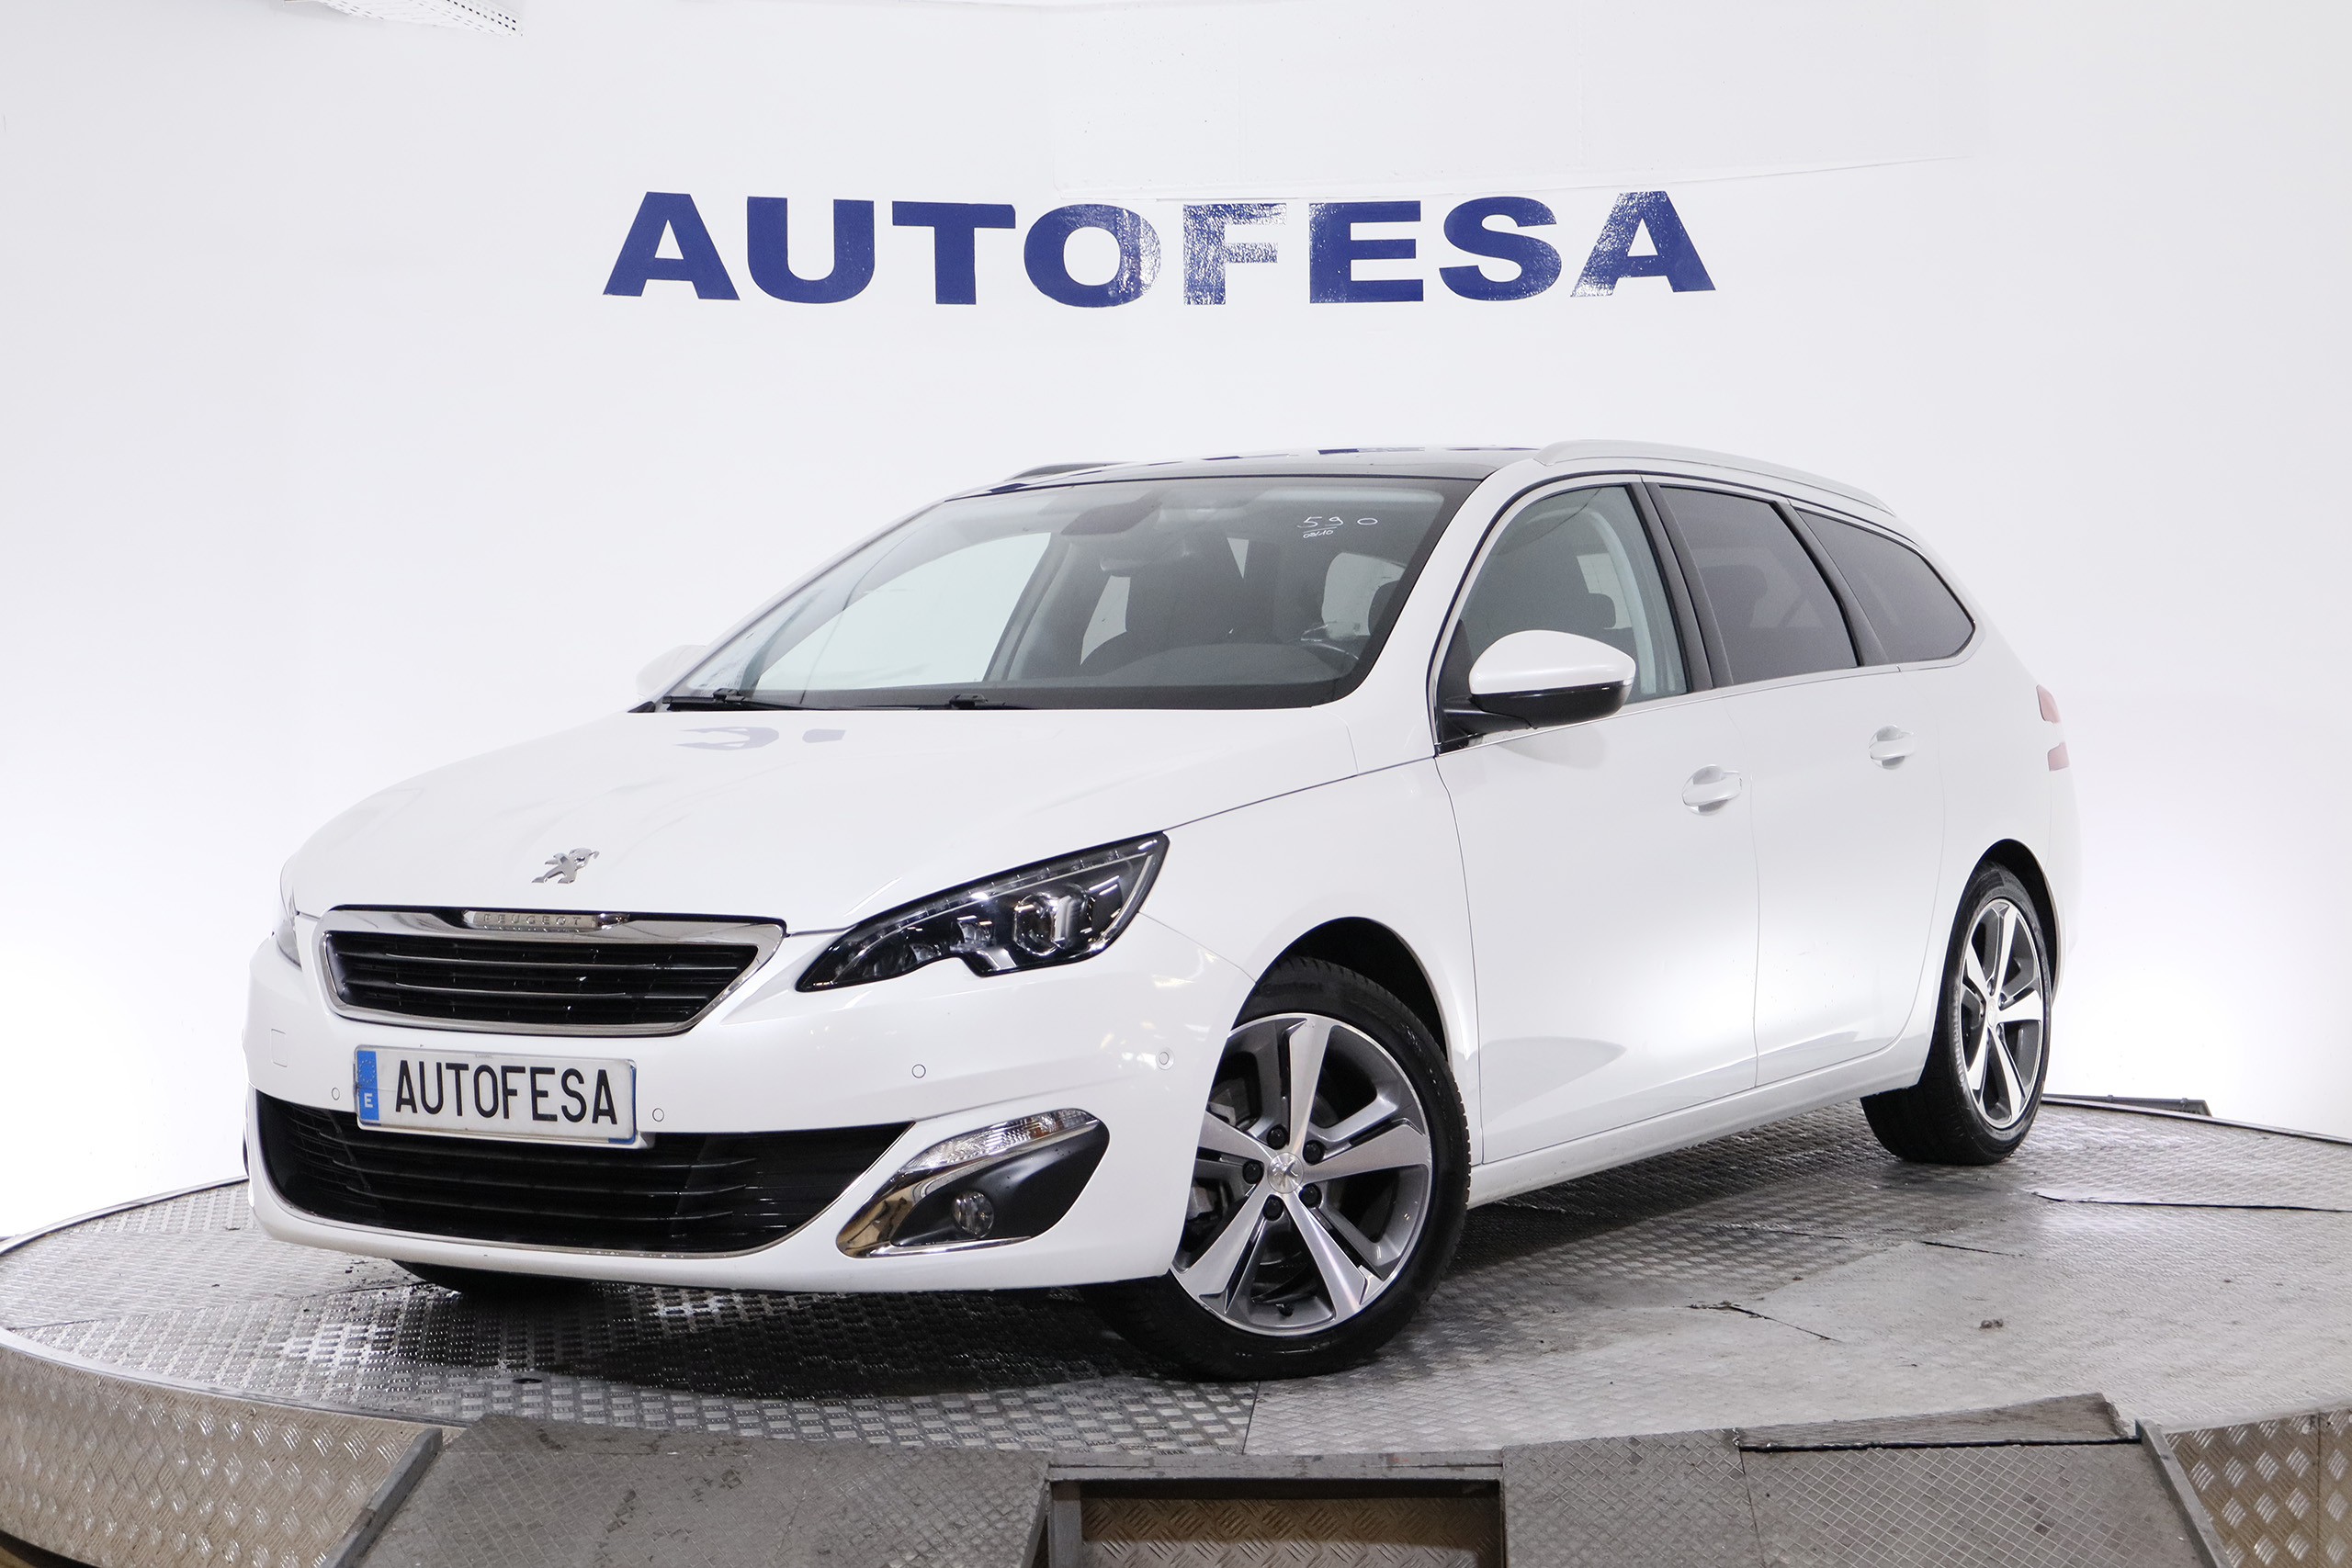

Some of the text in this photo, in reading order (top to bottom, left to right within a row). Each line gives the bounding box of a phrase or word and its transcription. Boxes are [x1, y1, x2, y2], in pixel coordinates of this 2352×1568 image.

[602, 190, 1715, 307] AUTOFESA
[483, 913, 582, 926] PEUGEOT
[364, 1092, 374, 1109] E
[395, 1059, 618, 1125] AUTOFESA
